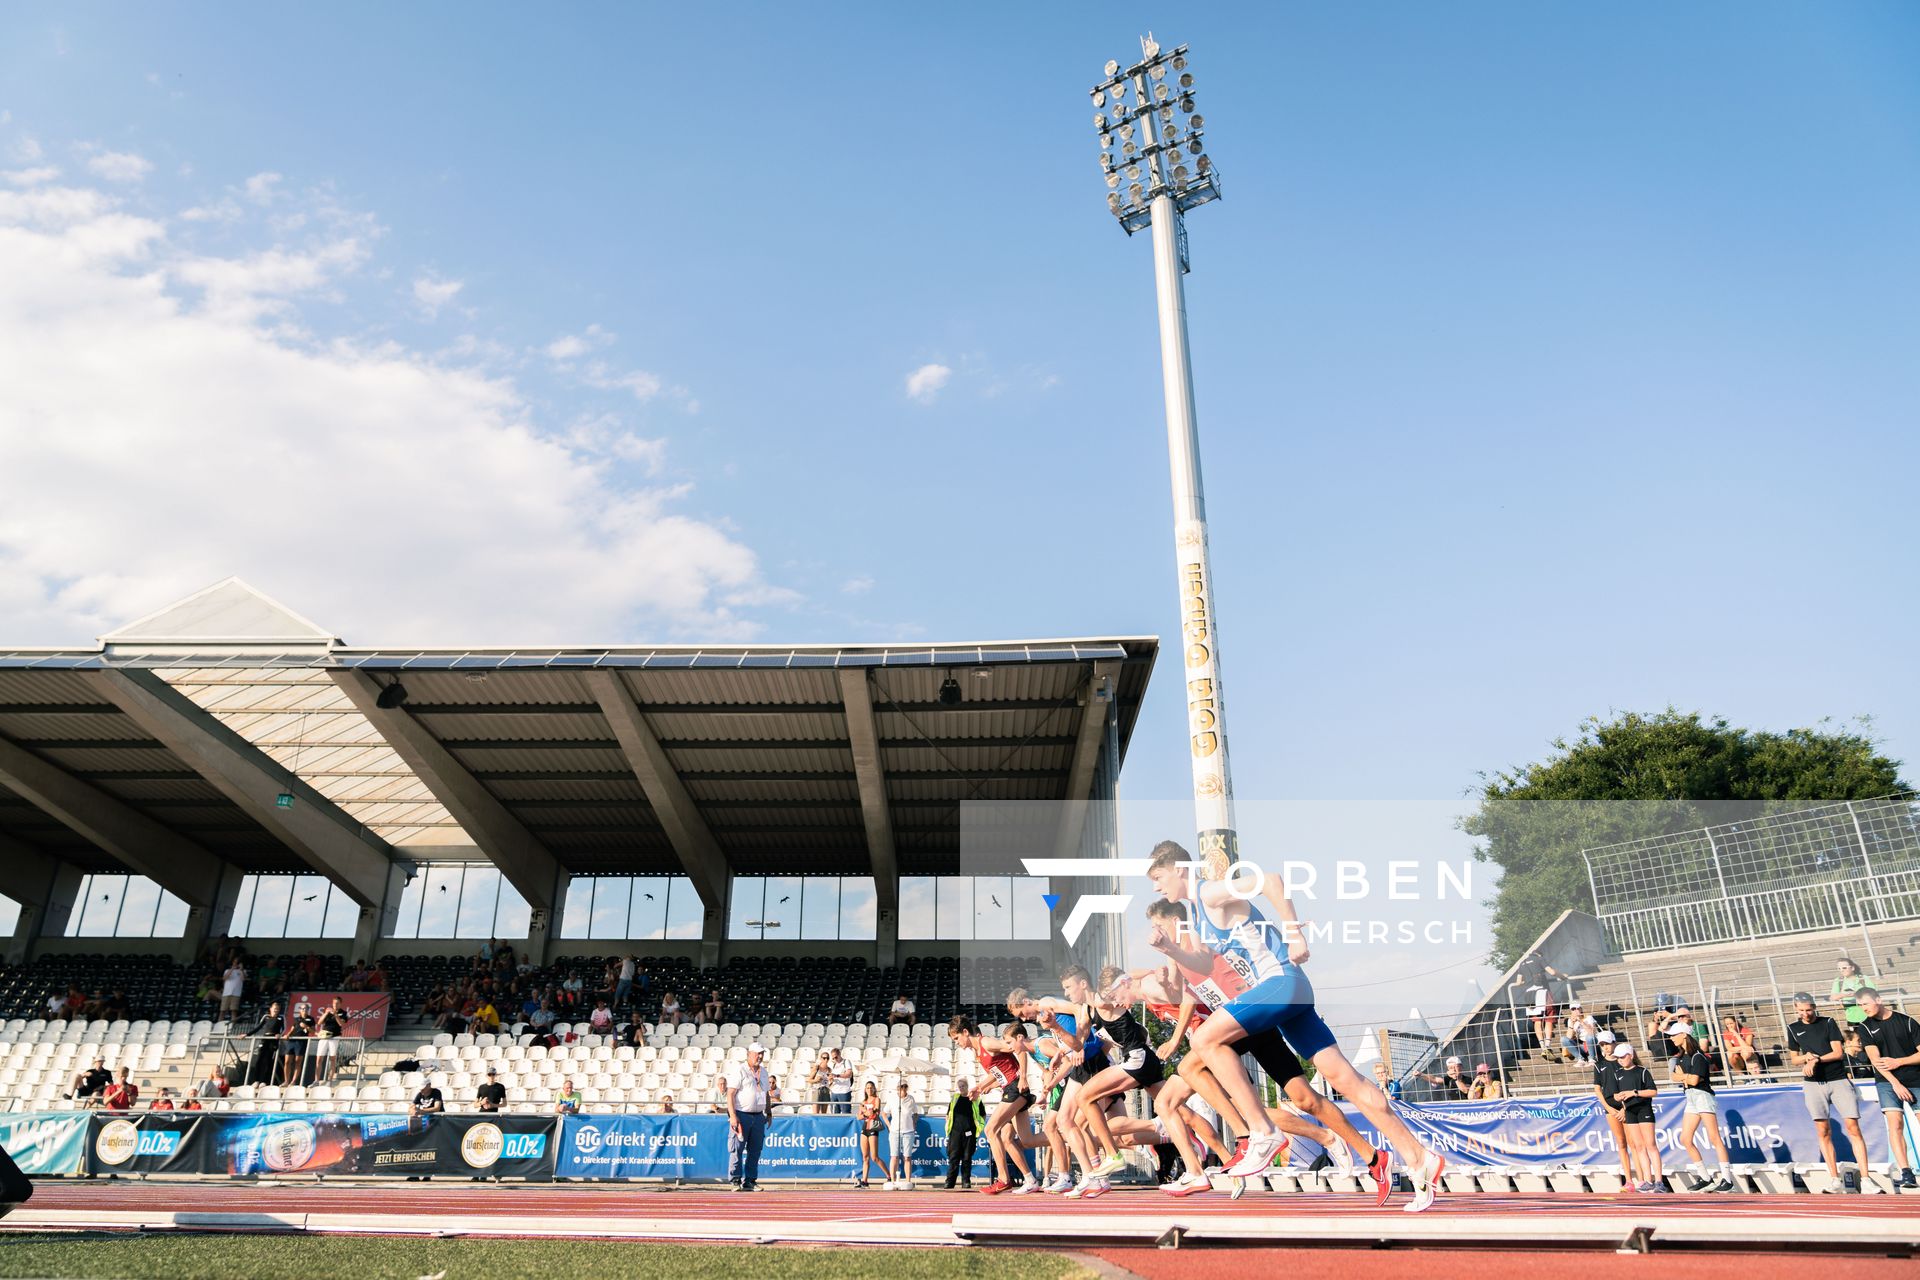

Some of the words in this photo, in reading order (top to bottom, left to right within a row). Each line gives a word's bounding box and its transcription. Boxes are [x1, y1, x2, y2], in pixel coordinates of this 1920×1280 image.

[1183, 562, 1210, 668] Ochsen
[1188, 678, 1218, 758] Gold
[317, 1005, 381, 1020] Skasse
[1460, 1109, 1526, 1121] CHAMPIONSHIPS
[1528, 1109, 1566, 1119] MUNICH
[1568, 1107, 1592, 1118] 2022
[282, 1127, 293, 1167] Warsteiner
[466, 1138, 500, 1151] Warsteiner
[575, 1133, 601, 1147] BIG
[605, 1132, 645, 1147] direkt
[649, 1132, 697, 1152] gesund
[765, 1133, 805, 1148] direkt
[809, 1133, 858, 1152] gesund
[1465, 1130, 1577, 1155] ATHLETICS
[375, 1154, 392, 1164] JETZT
[393, 1151, 436, 1162] ERFRISCHEN
[582, 1156, 610, 1165] Direkter
[611, 1156, 628, 1167] geht
[629, 1156, 676, 1165] Krankenkasse
[677, 1157, 696, 1165] nicht.
[772, 1157, 788, 1167] geht
[789, 1157, 837, 1166] Krankenkasse
[840, 1157, 858, 1166] nicht.
[933, 1158, 949, 1168] geht
